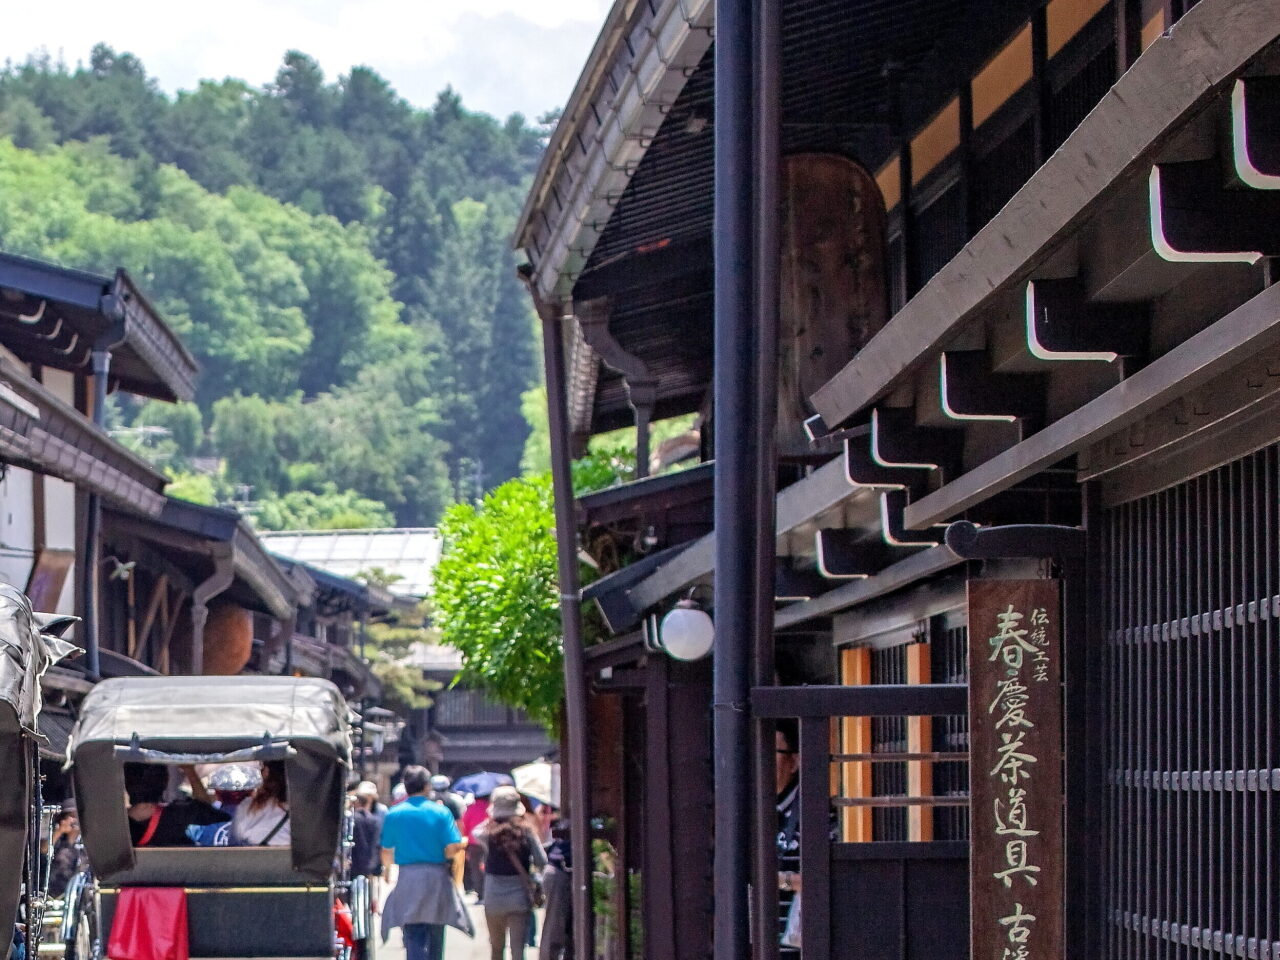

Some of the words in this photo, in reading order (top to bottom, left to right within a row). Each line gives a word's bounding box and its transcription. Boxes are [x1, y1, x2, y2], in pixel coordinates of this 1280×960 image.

[1030, 607, 1050, 683] 伝統工芸
[988, 604, 1041, 888] 春慶茶道具
